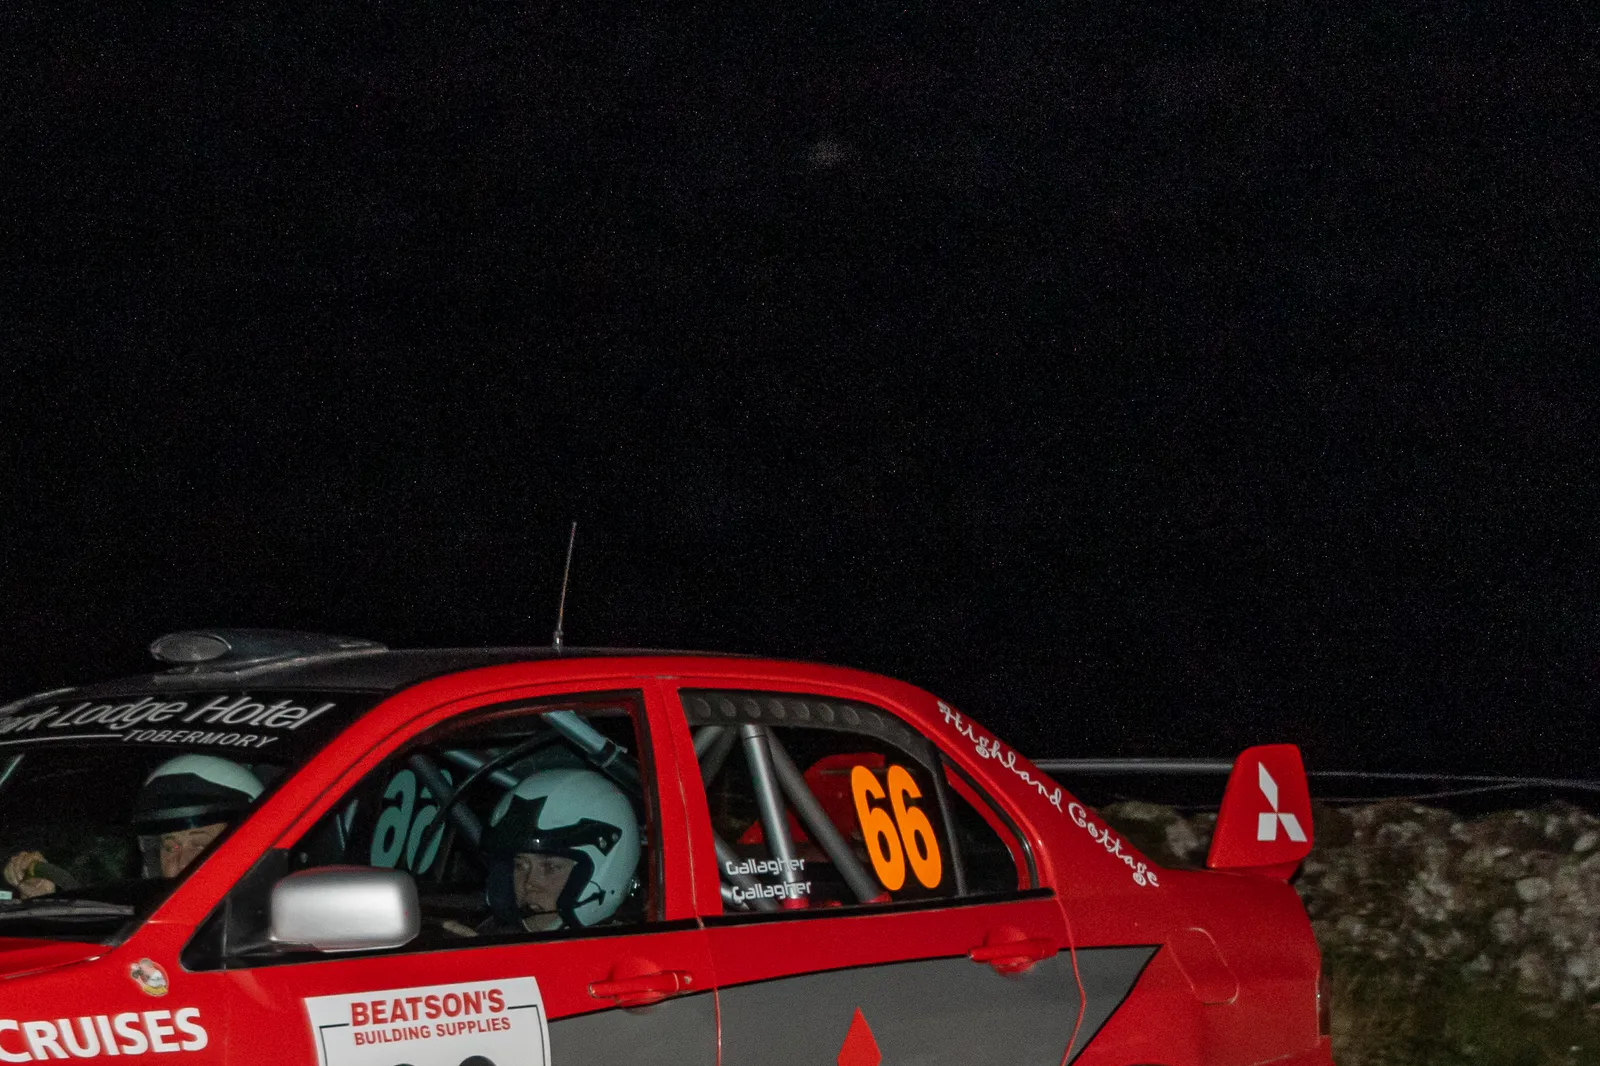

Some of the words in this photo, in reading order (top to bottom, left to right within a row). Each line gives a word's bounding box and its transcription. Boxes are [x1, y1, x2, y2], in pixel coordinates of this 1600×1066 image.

[48, 697, 186, 730] Lodge
[183, 696, 336, 731] Hotel
[121, 729, 280, 749] TOBERMORY
[937, 700, 1063, 813] Highland
[1068, 802, 1160, 888] Cottage
[851, 765, 943, 891] 66
[725, 857, 805, 876] Gallagher
[732, 881, 811, 901] Gallagher
[351, 989, 505, 1026] BEATSON'S
[353, 1026, 431, 1045] BUILDING
[436, 1017, 511, 1037] SUPPLIES
